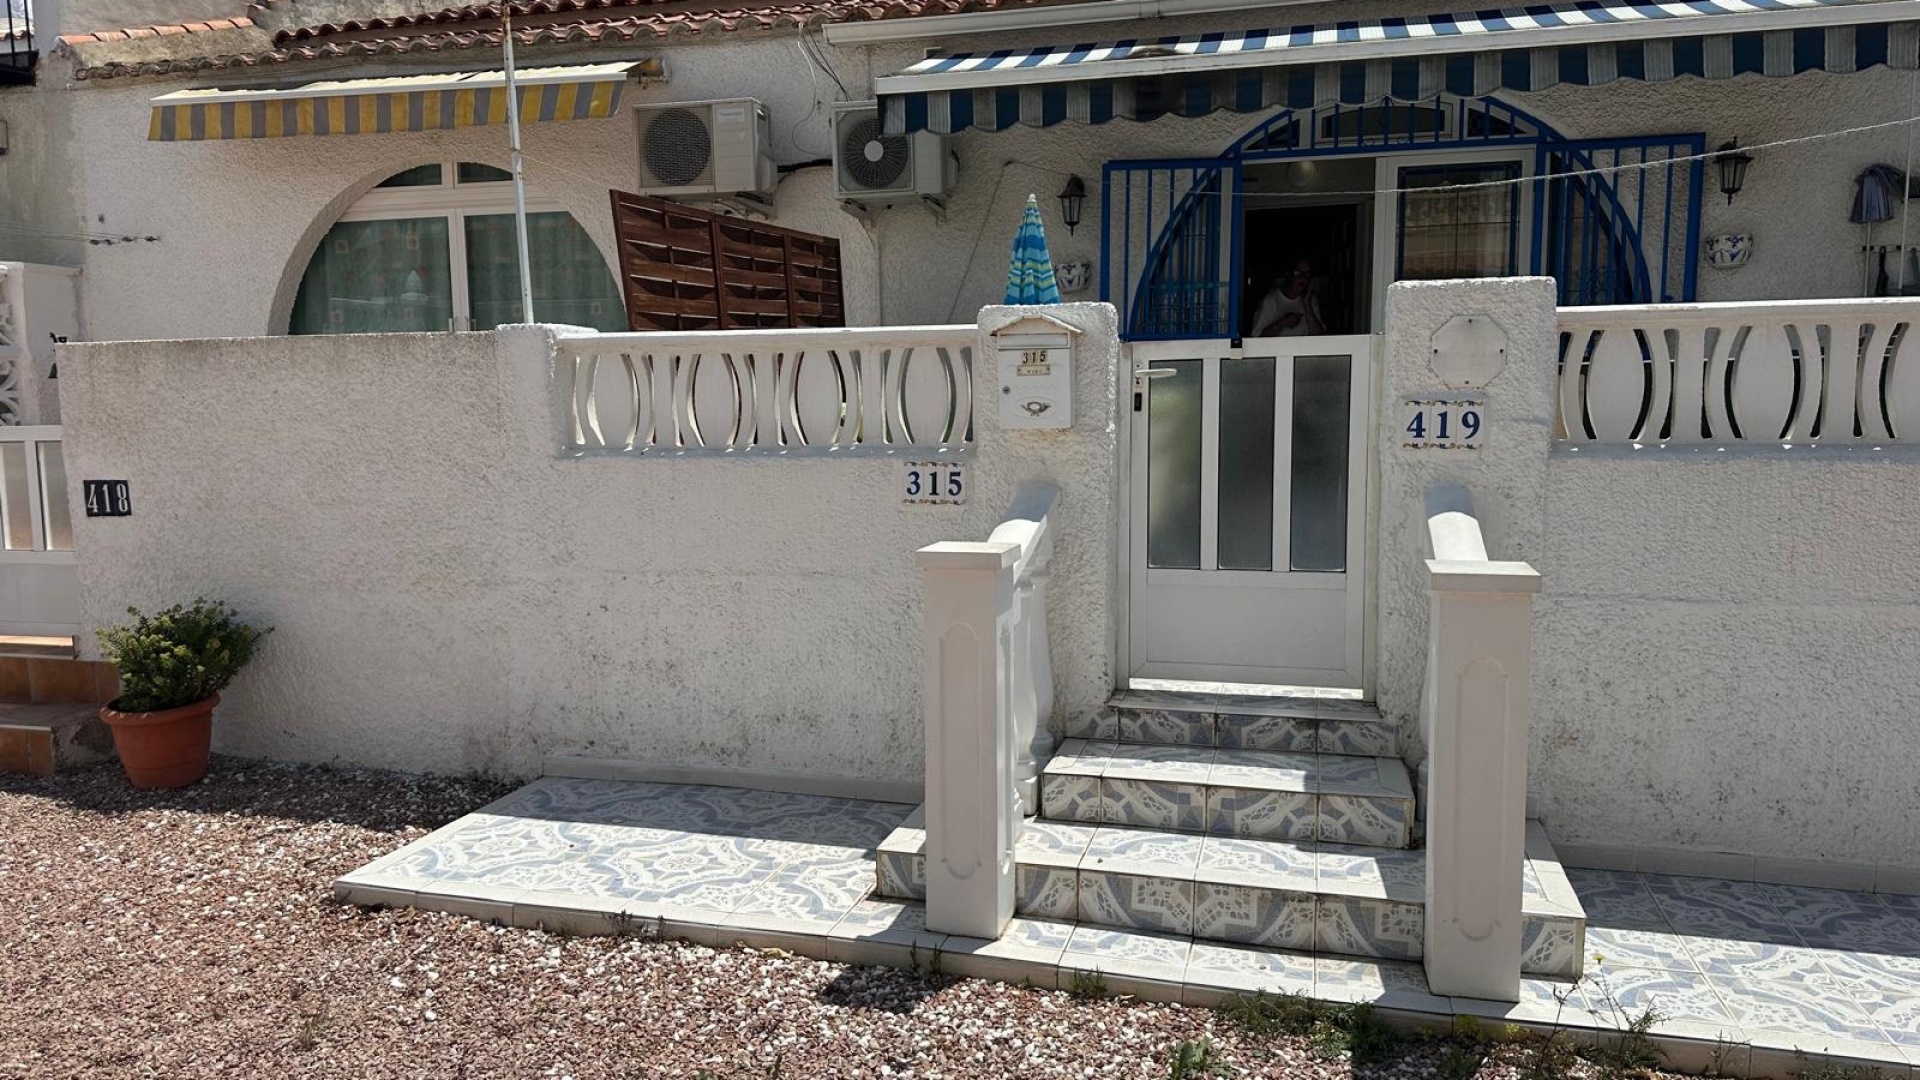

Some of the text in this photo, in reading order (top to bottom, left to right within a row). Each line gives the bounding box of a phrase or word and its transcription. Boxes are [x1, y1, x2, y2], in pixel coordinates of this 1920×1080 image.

[1021, 350, 1047, 364] 315
[1406, 410, 1480, 440] 419
[87, 482, 129, 513] 418
[906, 470, 963, 497] 315
